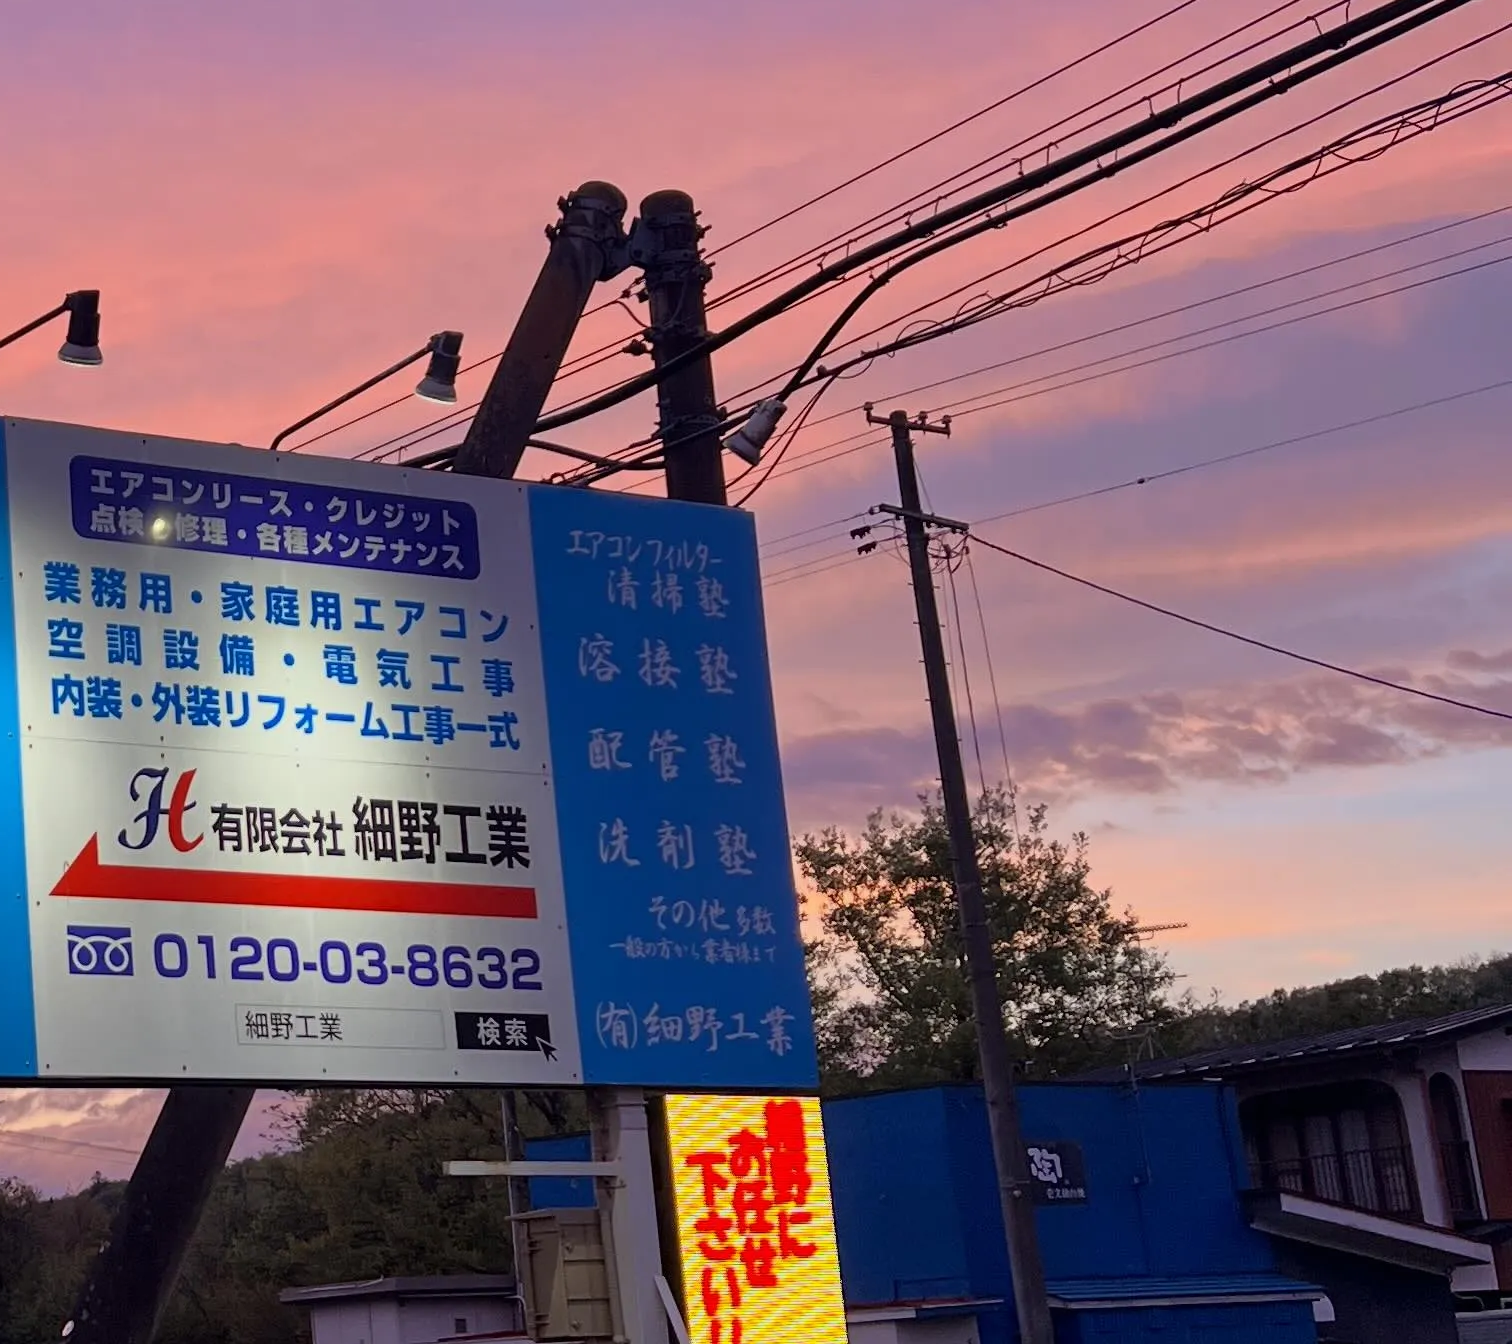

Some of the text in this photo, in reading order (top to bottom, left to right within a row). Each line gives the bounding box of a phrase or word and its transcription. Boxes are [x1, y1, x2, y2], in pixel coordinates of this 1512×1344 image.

[90, 468, 461, 532] エアコンリース・クレジット
[90, 502, 465, 571] 点検修理・各種メンテナンス
[566, 530, 723, 573] エアコンフィルター
[43, 561, 510, 643] 業務用・家庭用エアコン
[607, 566, 730, 618] 清掃塾
[48, 617, 515, 697] 空調設備・電気工事
[578, 633, 738, 694] 溶接塾
[51, 674, 521, 750] 内装・外装リフォーム工事一式
[588, 728, 746, 784] 配管塾
[211, 803, 346, 856] 有限会社
[352, 796, 531, 869] 細野工業
[598, 817, 757, 875] 洗剤塾
[154, 932, 543, 991] 0120-03-8632
[244, 1011, 528, 1047] 細野工業 検索
